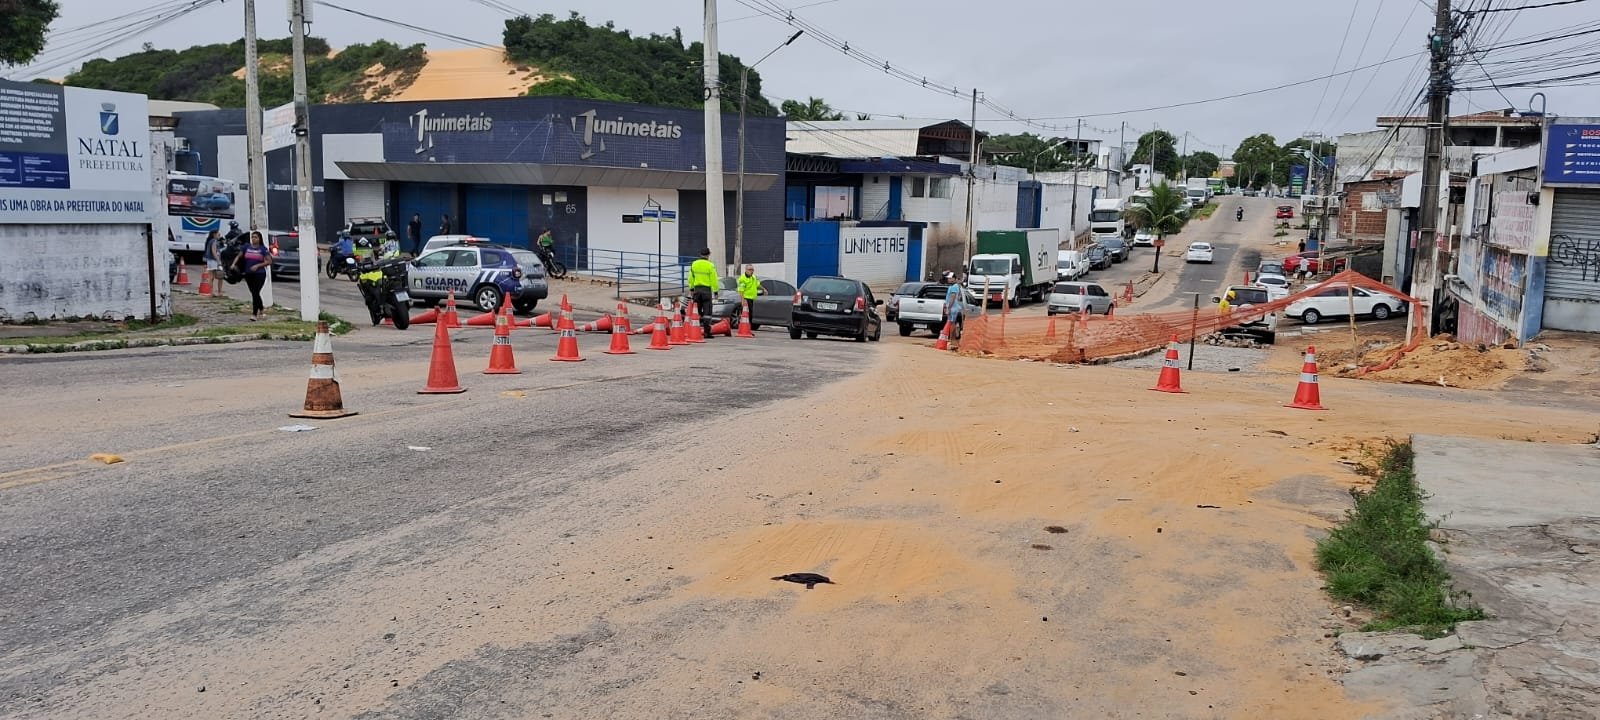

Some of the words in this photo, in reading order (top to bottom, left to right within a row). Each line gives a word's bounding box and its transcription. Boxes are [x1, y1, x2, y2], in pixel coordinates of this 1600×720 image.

[424, 112, 492, 131] unimetais
[594, 117, 682, 138] unimetais
[78, 137, 143, 158] NATAL
[80, 160, 143, 172] PREFEITURA
[9, 200, 28, 212] UMA
[30, 200, 52, 212] OBRA
[54, 200, 66, 212] DA
[66, 201, 111, 212] PREFEITURA
[112, 201, 124, 212] DO
[124, 201, 144, 212] NATAL
[566, 204, 576, 214] 65
[425, 276, 468, 287] GUARDA
